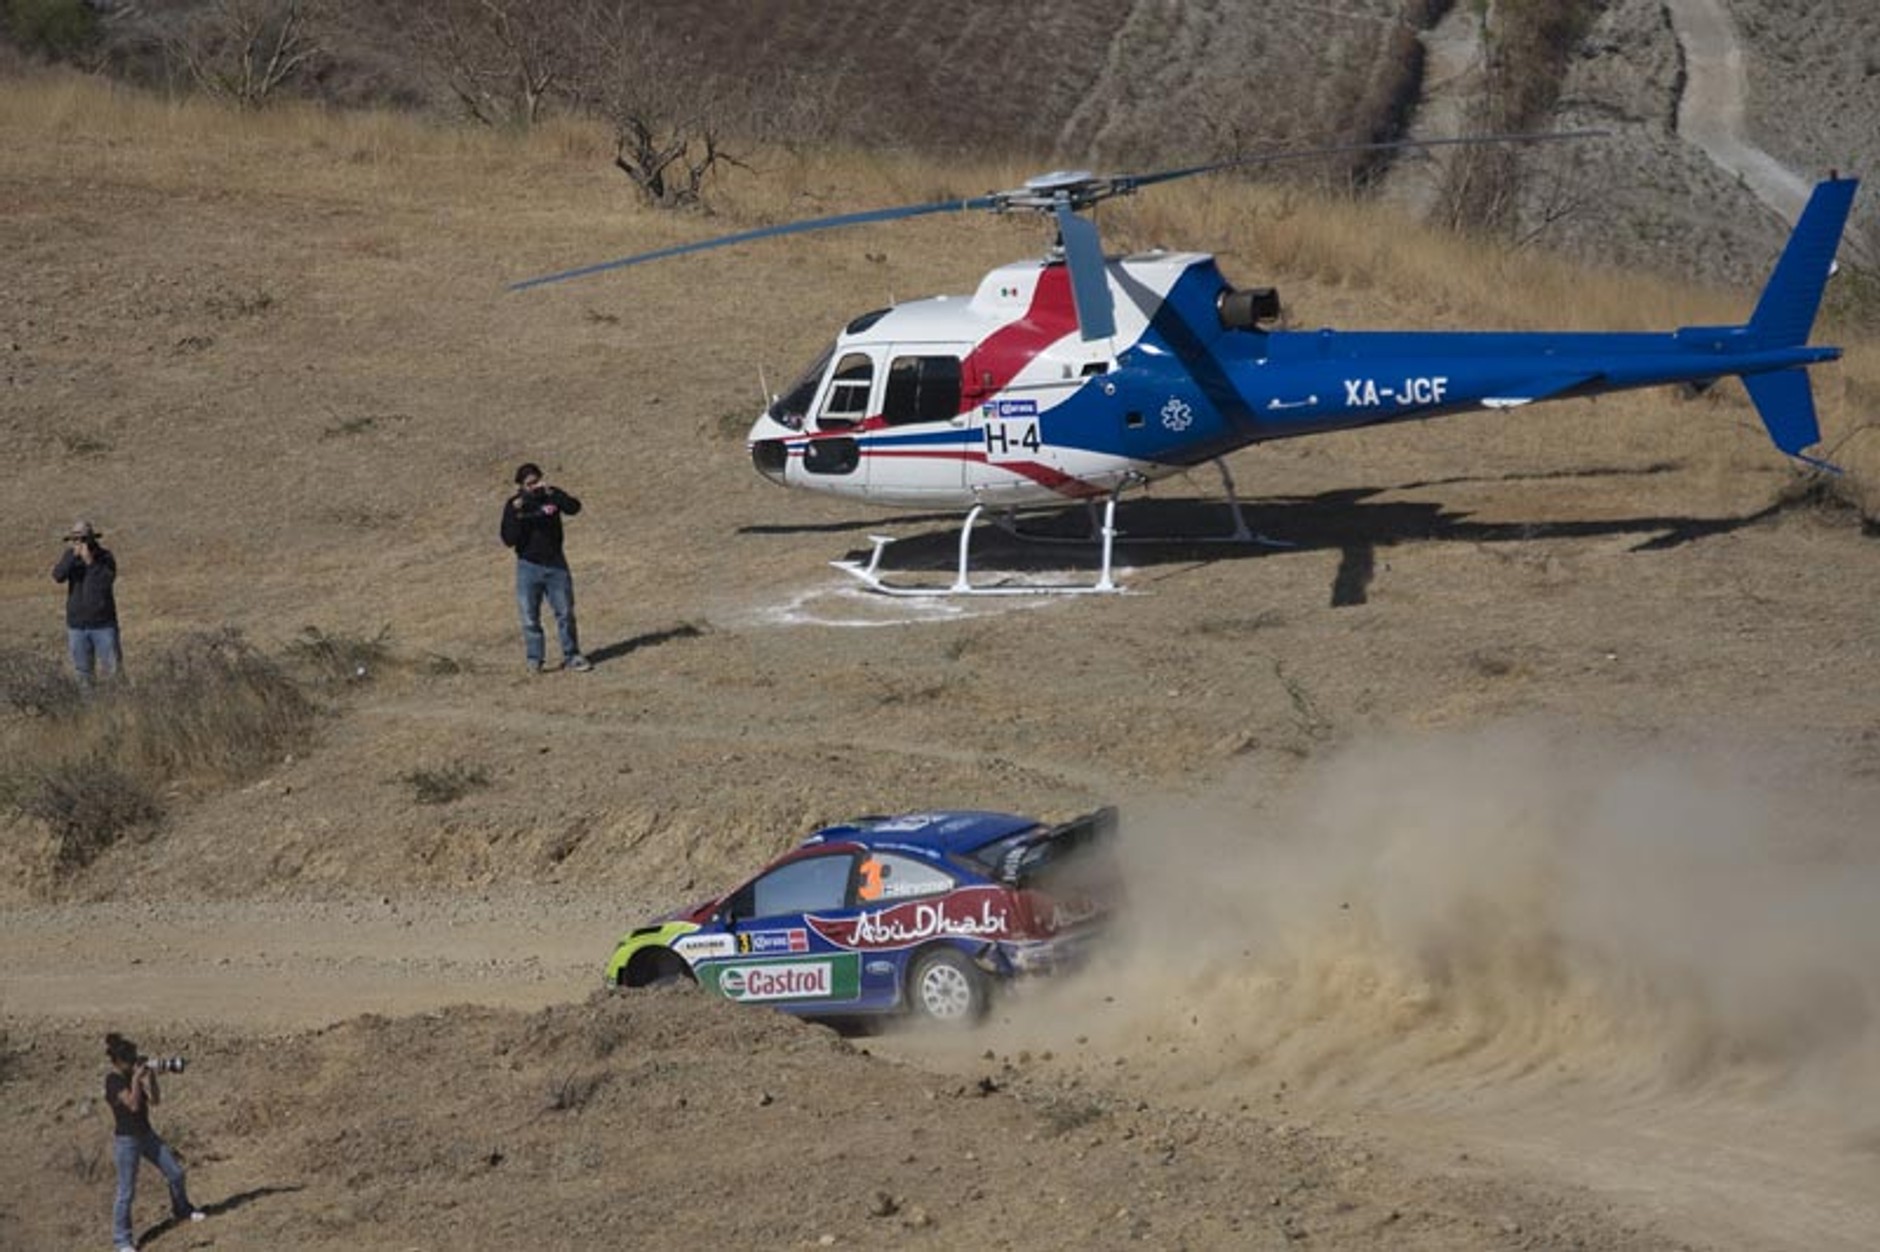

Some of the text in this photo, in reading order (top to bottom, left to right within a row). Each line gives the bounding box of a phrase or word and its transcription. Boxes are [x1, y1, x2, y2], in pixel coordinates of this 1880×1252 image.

[1344, 377, 1448, 406] XA-JCF
[986, 422, 1040, 453] H-4
[859, 857, 883, 900] 3
[847, 911, 915, 945] Abu
[915, 899, 1008, 937] Dhabi
[747, 967, 826, 995] Castrol
